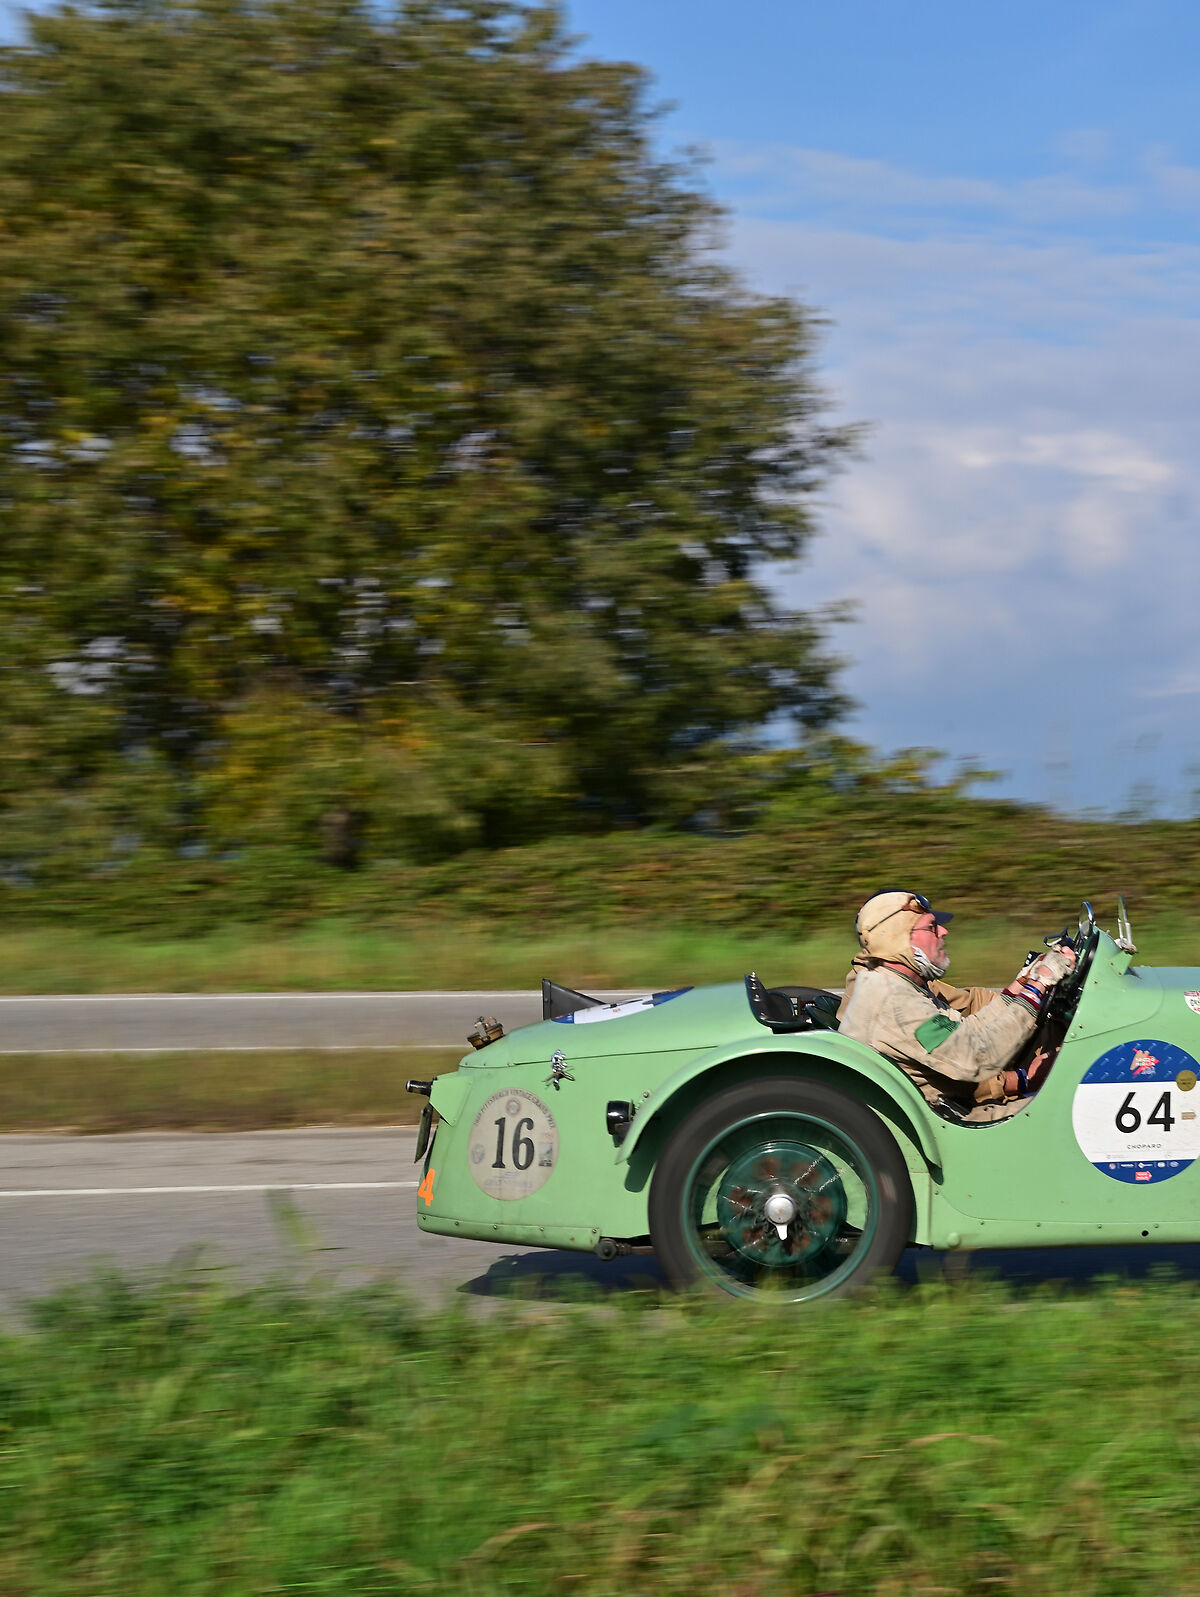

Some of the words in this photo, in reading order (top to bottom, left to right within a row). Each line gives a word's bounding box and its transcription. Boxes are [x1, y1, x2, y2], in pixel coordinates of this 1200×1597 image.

[1115, 1091, 1175, 1134] 64
[491, 1116, 535, 1171] 16
[417, 1168, 436, 1206] 4
